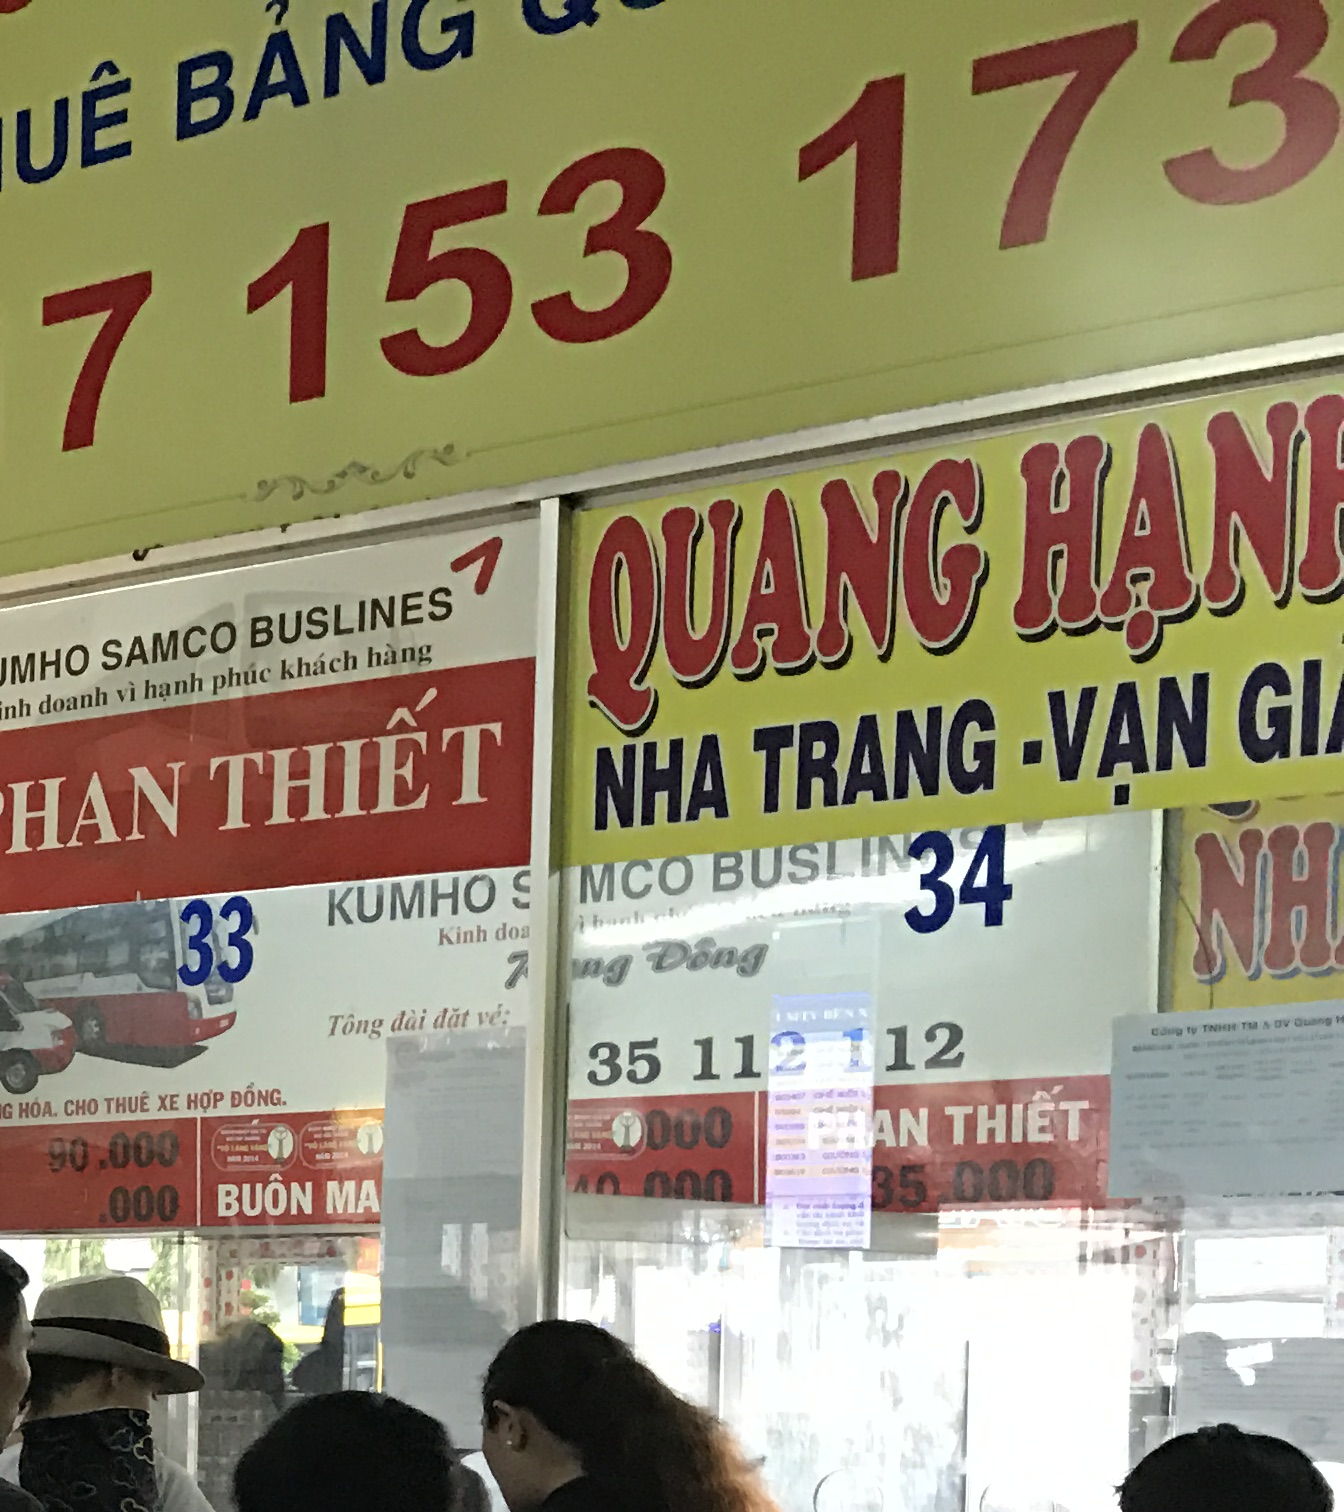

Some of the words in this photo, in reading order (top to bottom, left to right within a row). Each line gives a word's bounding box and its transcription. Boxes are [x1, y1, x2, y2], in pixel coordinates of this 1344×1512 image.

[176, 0, 475, 142] BẢNG
[246, 146, 673, 405] 153
[798, 0, 1342, 284] 173
[101, 621, 237, 672] SAMCO
[250, 586, 454, 648] BUSLINES
[588, 457, 988, 735] QUANG
[38, 688, 109, 714] doanh
[115, 681, 137, 703] vì
[143, 675, 205, 703] hạnh
[212, 663, 273, 696] phúc
[280, 652, 359, 682] khách
[366, 640, 433, 669] hàng
[211, 687, 503, 830] THIẾT
[594, 734, 730, 832] NHA
[752, 699, 998, 815] TRANG
[326, 874, 497, 927] KUMHO
[904, 823, 1014, 936] 34
[1192, 821, 1344, 985] NH
[177, 895, 256, 988] 33
[439, 925, 488, 947] Kinh
[642, 936, 770, 978] Đông
[390, 1007, 426, 1034] đài
[1203, 1024, 1236, 1033] TNHH
[585, 1037, 662, 1088] 35
[19, 1097, 58, 1119] HÓA.
[64, 1099, 98, 1118] CHO
[104, 1091, 150, 1114] THUÊ
[157, 1093, 180, 1111] XE
[185, 1090, 226, 1111] HỢP
[230, 1087, 287, 1108] ĐỒNG.
[944, 1085, 1090, 1145] THIẾT
[217, 1174, 312, 1217] BUÔN
[325, 1179, 381, 1215] MA
